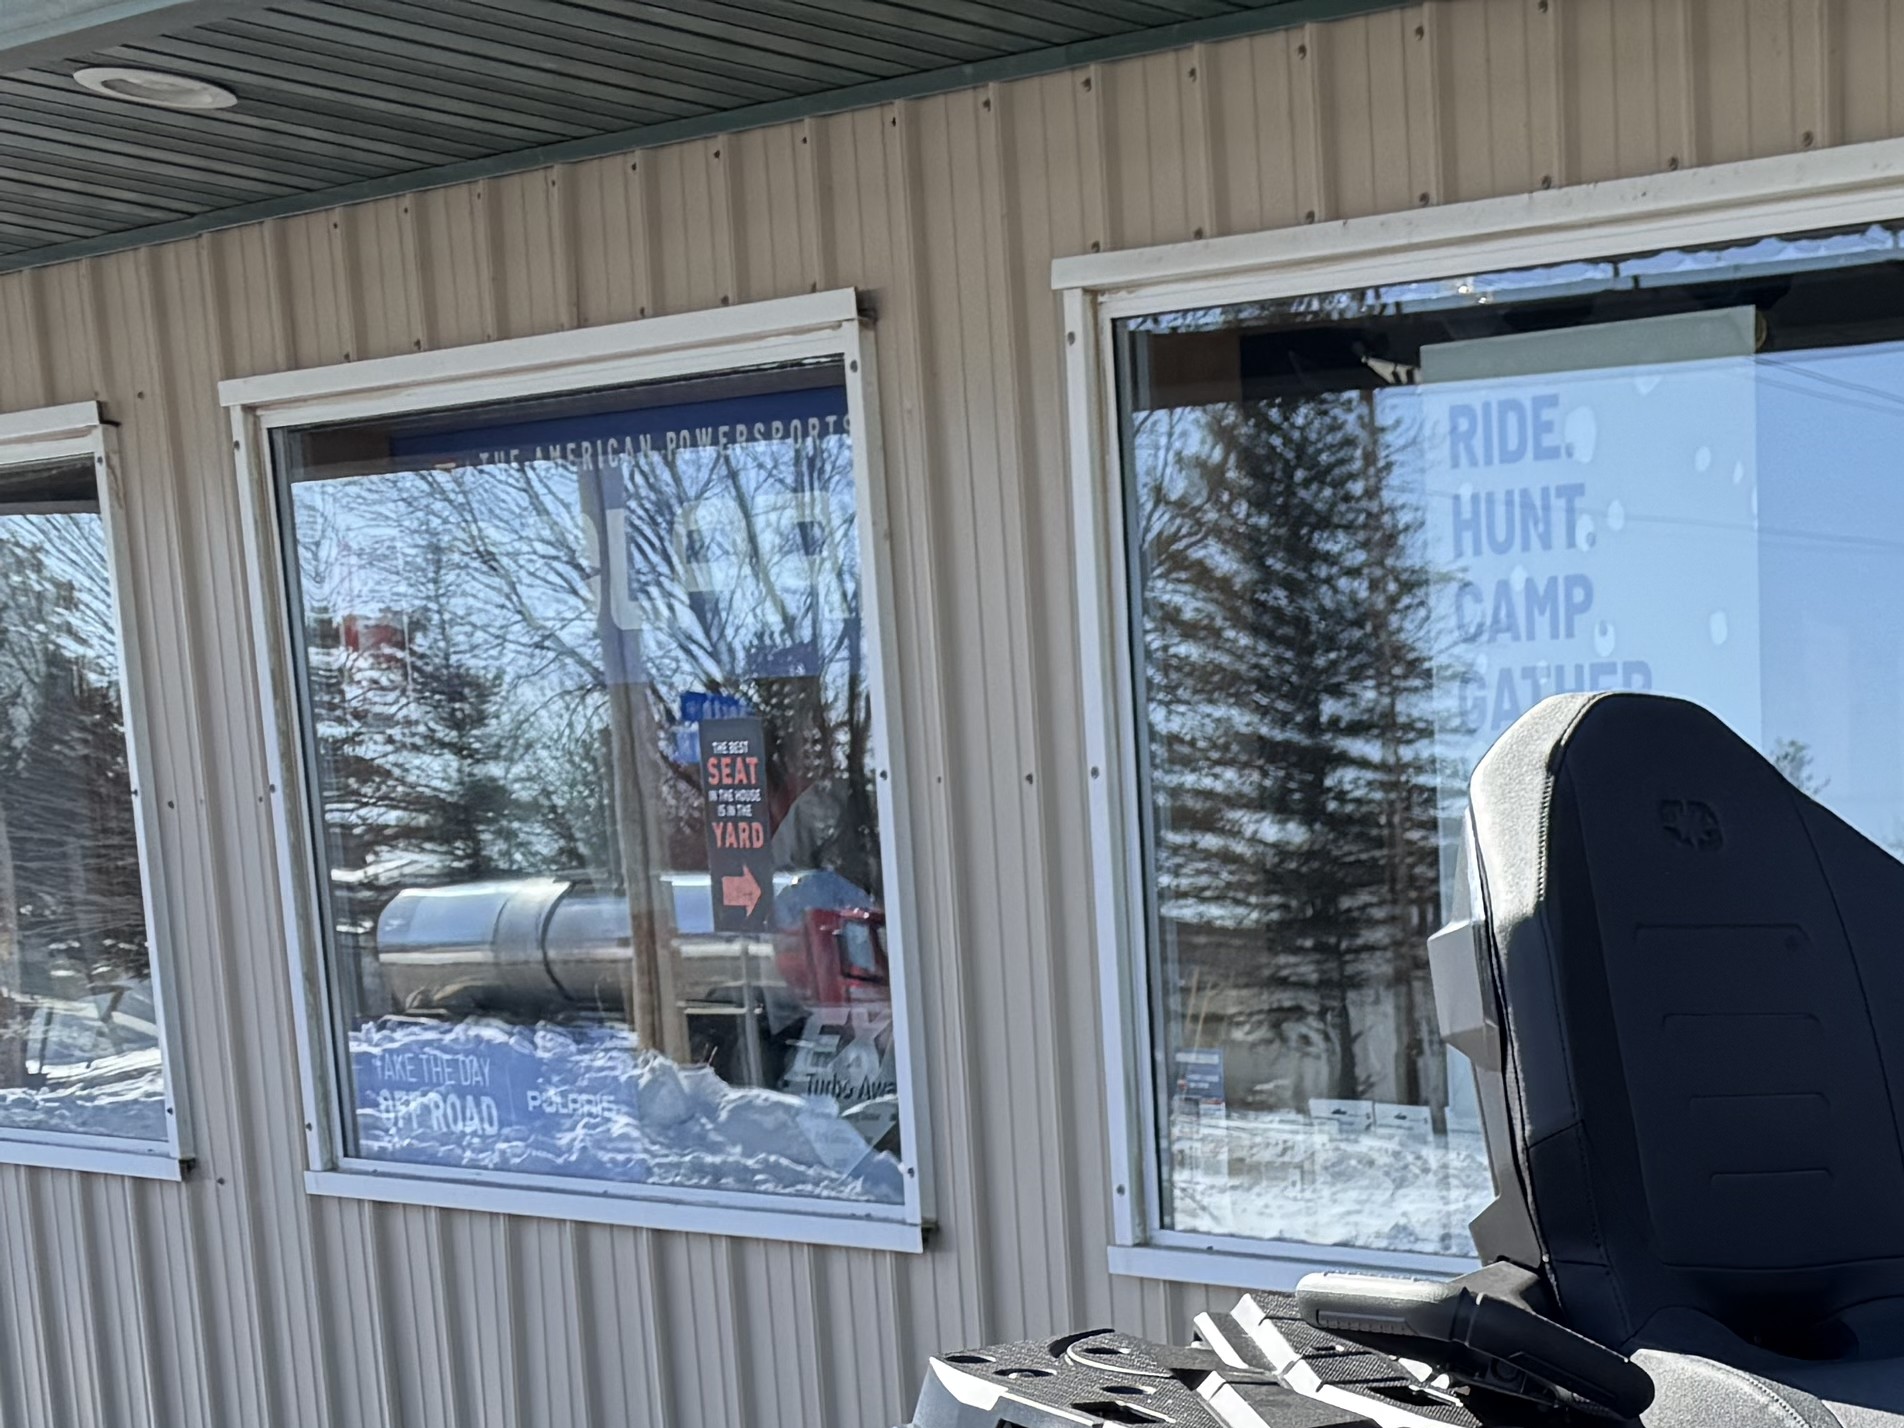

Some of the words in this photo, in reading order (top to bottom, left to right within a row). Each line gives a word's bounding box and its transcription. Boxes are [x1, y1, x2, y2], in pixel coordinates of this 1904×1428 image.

[534, 433, 652, 471] AMERICAN
[1448, 393, 1575, 469] RIDE.
[1451, 483, 1596, 559] HUNT.
[1454, 573, 1608, 645] CAMP.
[707, 756, 759, 785] SEAT
[712, 821, 764, 849] YARD
[373, 1052, 418, 1083] TAKE
[419, 1053, 454, 1086] THE
[459, 1055, 490, 1088] DAY
[377, 1088, 422, 1130] OFF
[427, 1091, 498, 1136] ROAD
